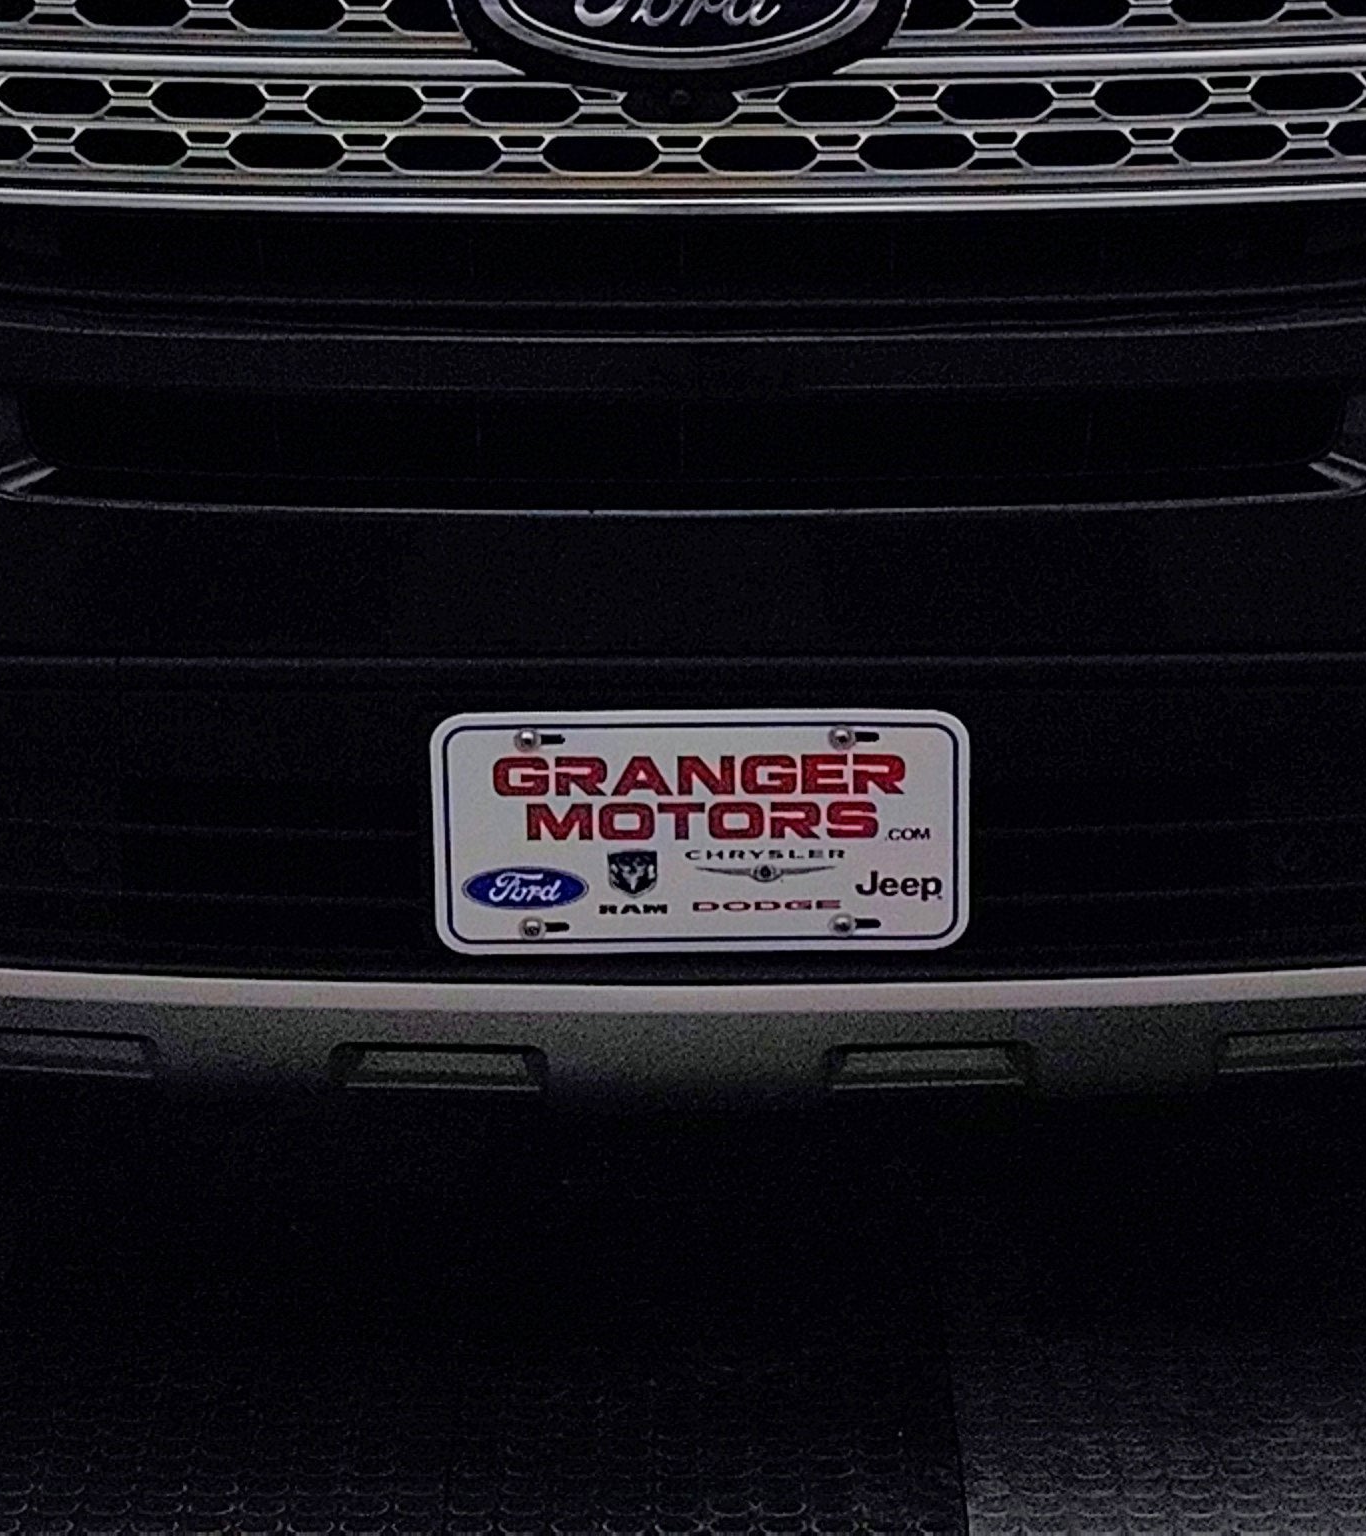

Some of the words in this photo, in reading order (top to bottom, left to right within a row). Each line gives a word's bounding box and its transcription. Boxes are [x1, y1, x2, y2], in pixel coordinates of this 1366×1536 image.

[492, 753, 906, 797] GRANGER
[525, 801, 880, 841] MOTORS
[684, 848, 847, 861] CHRYSLER
[488, 872, 562, 903] Ford
[854, 870, 943, 902] Jeep
[598, 904, 669, 915] RAM
[691, 898, 843, 912] DODGE
